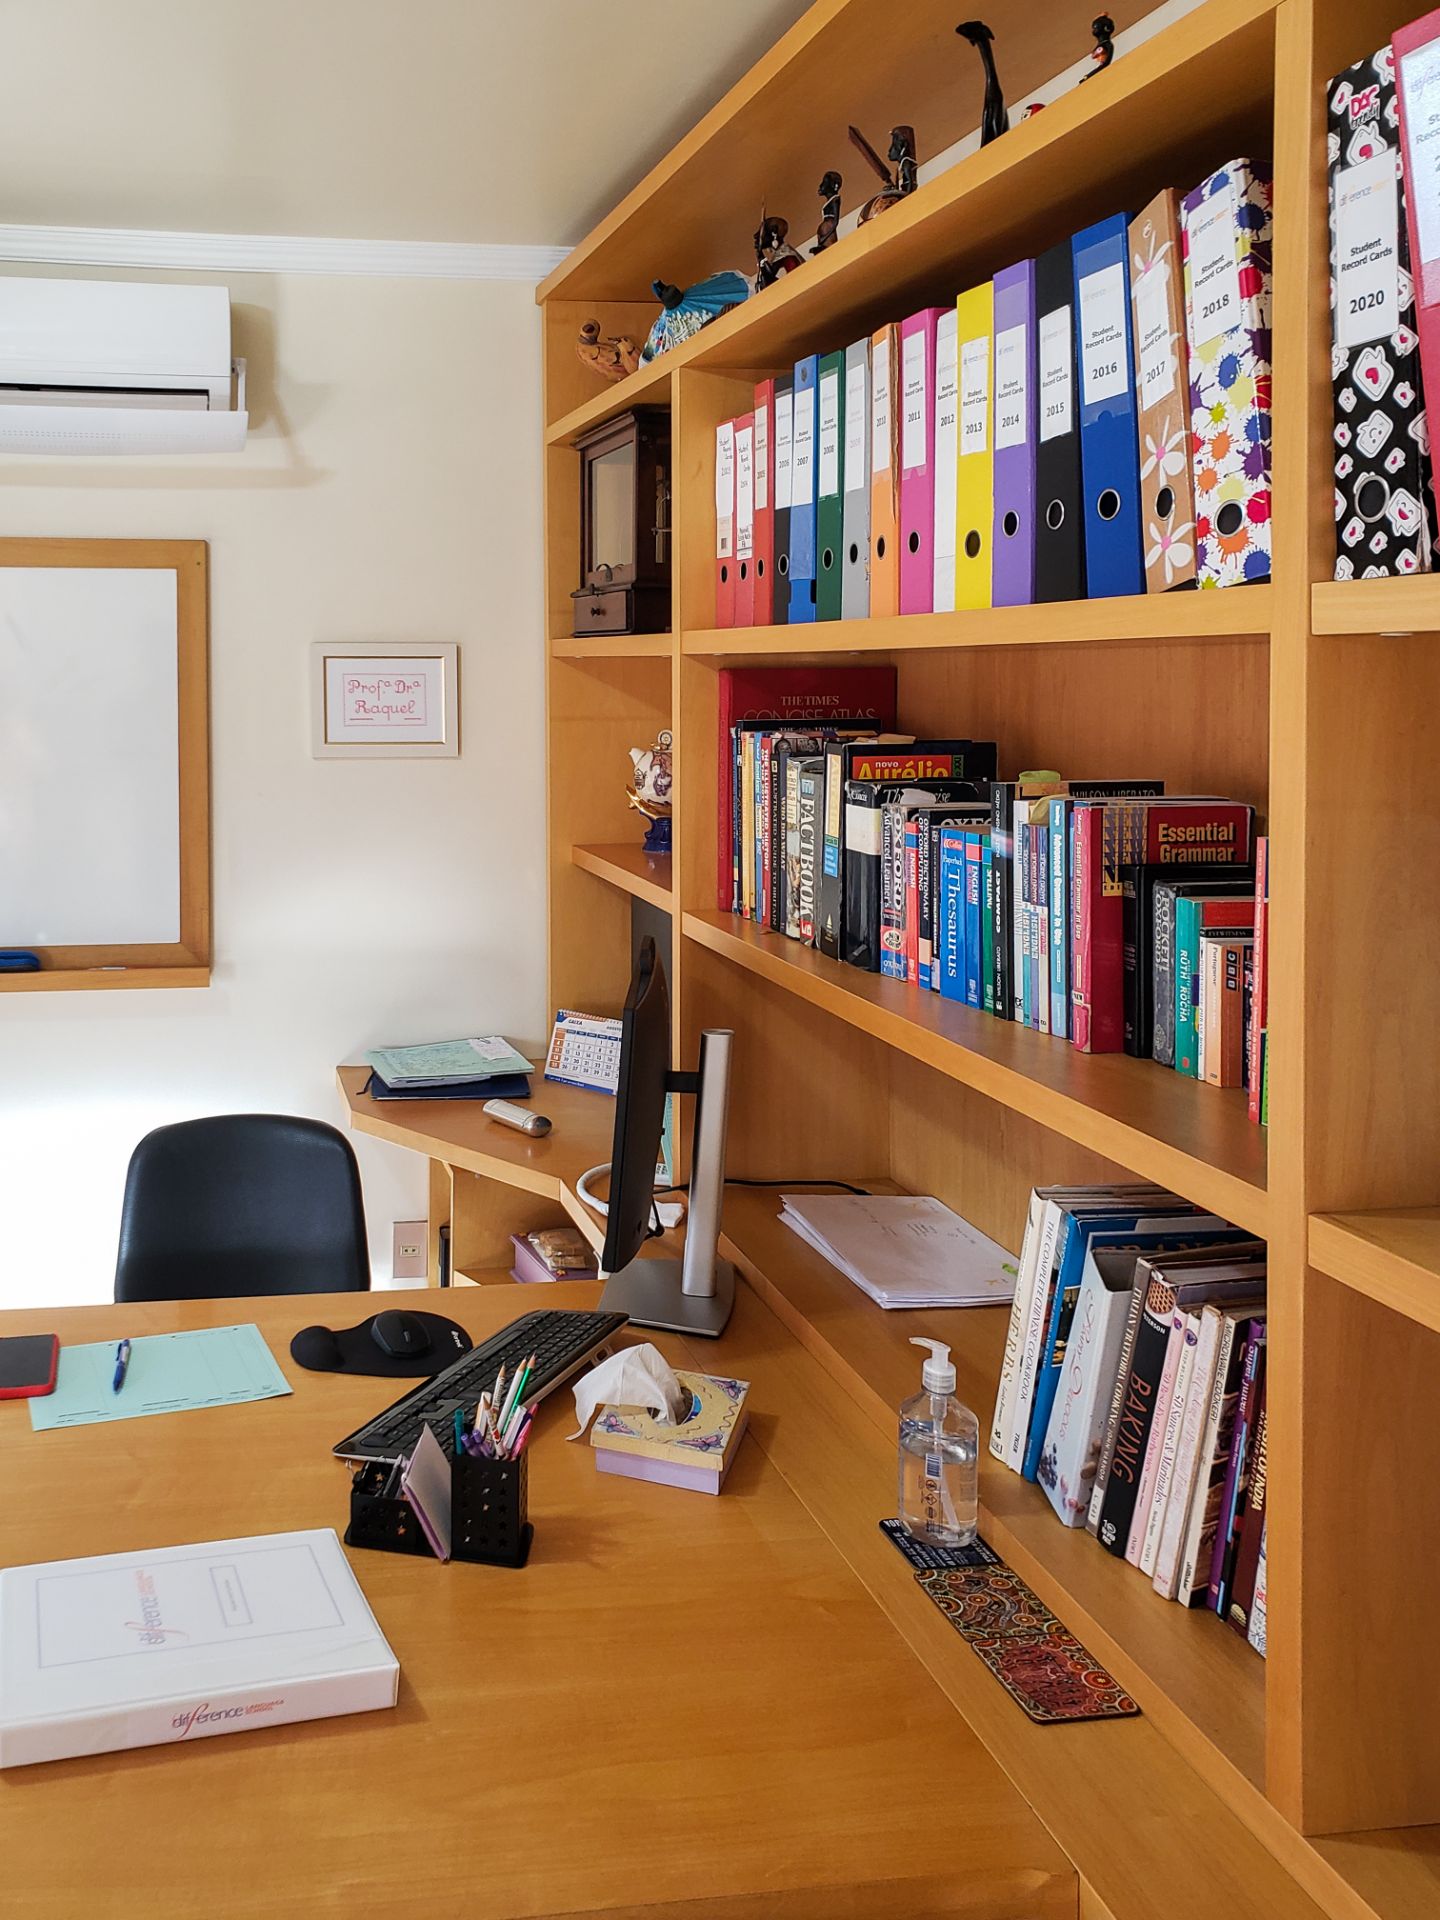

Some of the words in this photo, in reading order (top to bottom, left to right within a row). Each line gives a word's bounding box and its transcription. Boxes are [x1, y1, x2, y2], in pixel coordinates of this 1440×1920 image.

[1341, 255, 1368, 272] Record
[1370, 247, 1393, 261] Cards
[1350, 238, 1382, 257] Student
[1194, 268, 1215, 288] Record
[1216, 259, 1234, 274] Cards
[1201, 255, 1225, 274] Student
[1202, 294, 1230, 318] 2018
[1350, 290, 1385, 314] 2020
[1085, 337, 1105, 350] Record
[1105, 331, 1122, 344] Cards
[1091, 325, 1115, 338] Student
[1144, 324, 1162, 342] Student
[1047, 366, 1063, 379] Student
[1056, 373, 1069, 383] Cards
[1092, 362, 1118, 380] 2016
[1146, 361, 1166, 384] 2017
[1002, 379, 1018, 391] Student
[908, 410, 921, 423] 2011
[940, 413, 955, 427] 2012
[1001, 414, 1020, 428] 2014
[1046, 402, 1065, 417] 2015
[965, 422, 983, 435] 2013
[797, 456, 809, 466] 2007
[823, 444, 835, 455] 2008
[355, 699, 416, 721] Raquel
[781, 695, 804, 706] THE
[804, 695, 840, 706] TIMES
[858, 760, 949, 780] Aurélio
[883, 811, 891, 860] Advanced
[1158, 822, 1234, 842] Essential
[800, 797, 815, 920] FACTBOOK
[894, 812, 903, 911] OXFORD
[1053, 833, 1062, 876] Advanced
[1159, 844, 1235, 863] Grammar
[883, 862, 892, 908] Learner's
[1053, 877, 1062, 917] Grammar
[948, 868, 961, 978] Thesaurus
[1161, 896, 1170, 967] POCKET
[1179, 949, 1188, 979] RUTH
[1227, 951, 1237, 991] BBC
[1179, 985, 1188, 1022] ROCHA
[1046, 1221, 1055, 1240] THE
[1037, 1241, 1053, 1296] COMPLETE
[1127, 1287, 1143, 1324] ITALIAN
[1029, 1296, 1044, 1340] CHINESE
[1002, 1303, 1022, 1383] HERBS
[1117, 1327, 1134, 1381] TRATTORIA
[1216, 1323, 1233, 1380] MICROWAVE
[1020, 1340, 1038, 1400] COOKBOOK
[1108, 1382, 1124, 1428] COOKING
[1174, 1394, 1184, 1408] 50
[1209, 1380, 1223, 1425] COOKERY
[1112, 1370, 1151, 1484] BAKING
[1166, 1408, 1181, 1441] Sauces
[1105, 1428, 1114, 1449] JOHN
[1155, 1454, 1173, 1504] Marinades
[1251, 1474, 1266, 1511] INDIA
